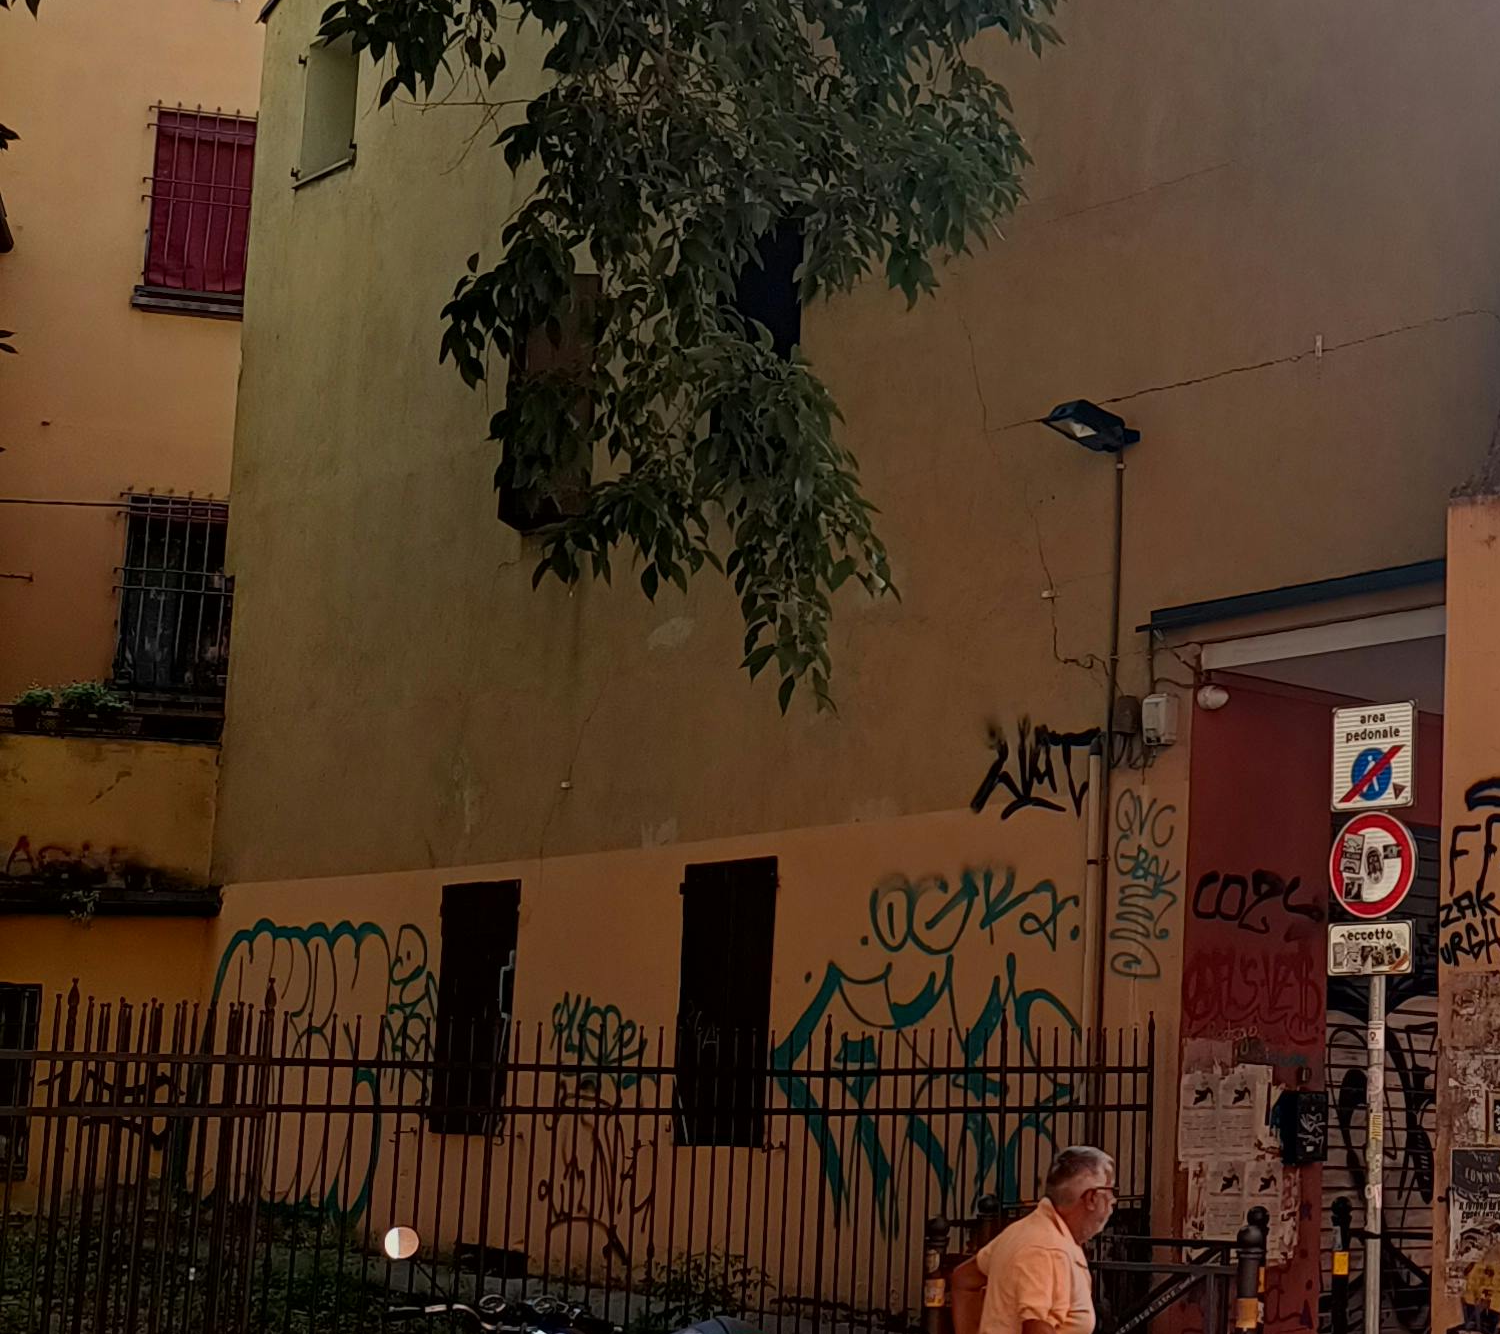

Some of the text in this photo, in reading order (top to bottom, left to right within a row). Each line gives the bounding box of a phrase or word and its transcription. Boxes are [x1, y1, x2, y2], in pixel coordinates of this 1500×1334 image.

[1360, 712, 1386, 724] area
[1346, 726, 1401, 743] pedonale
[1347, 927, 1393, 941] eccetto
